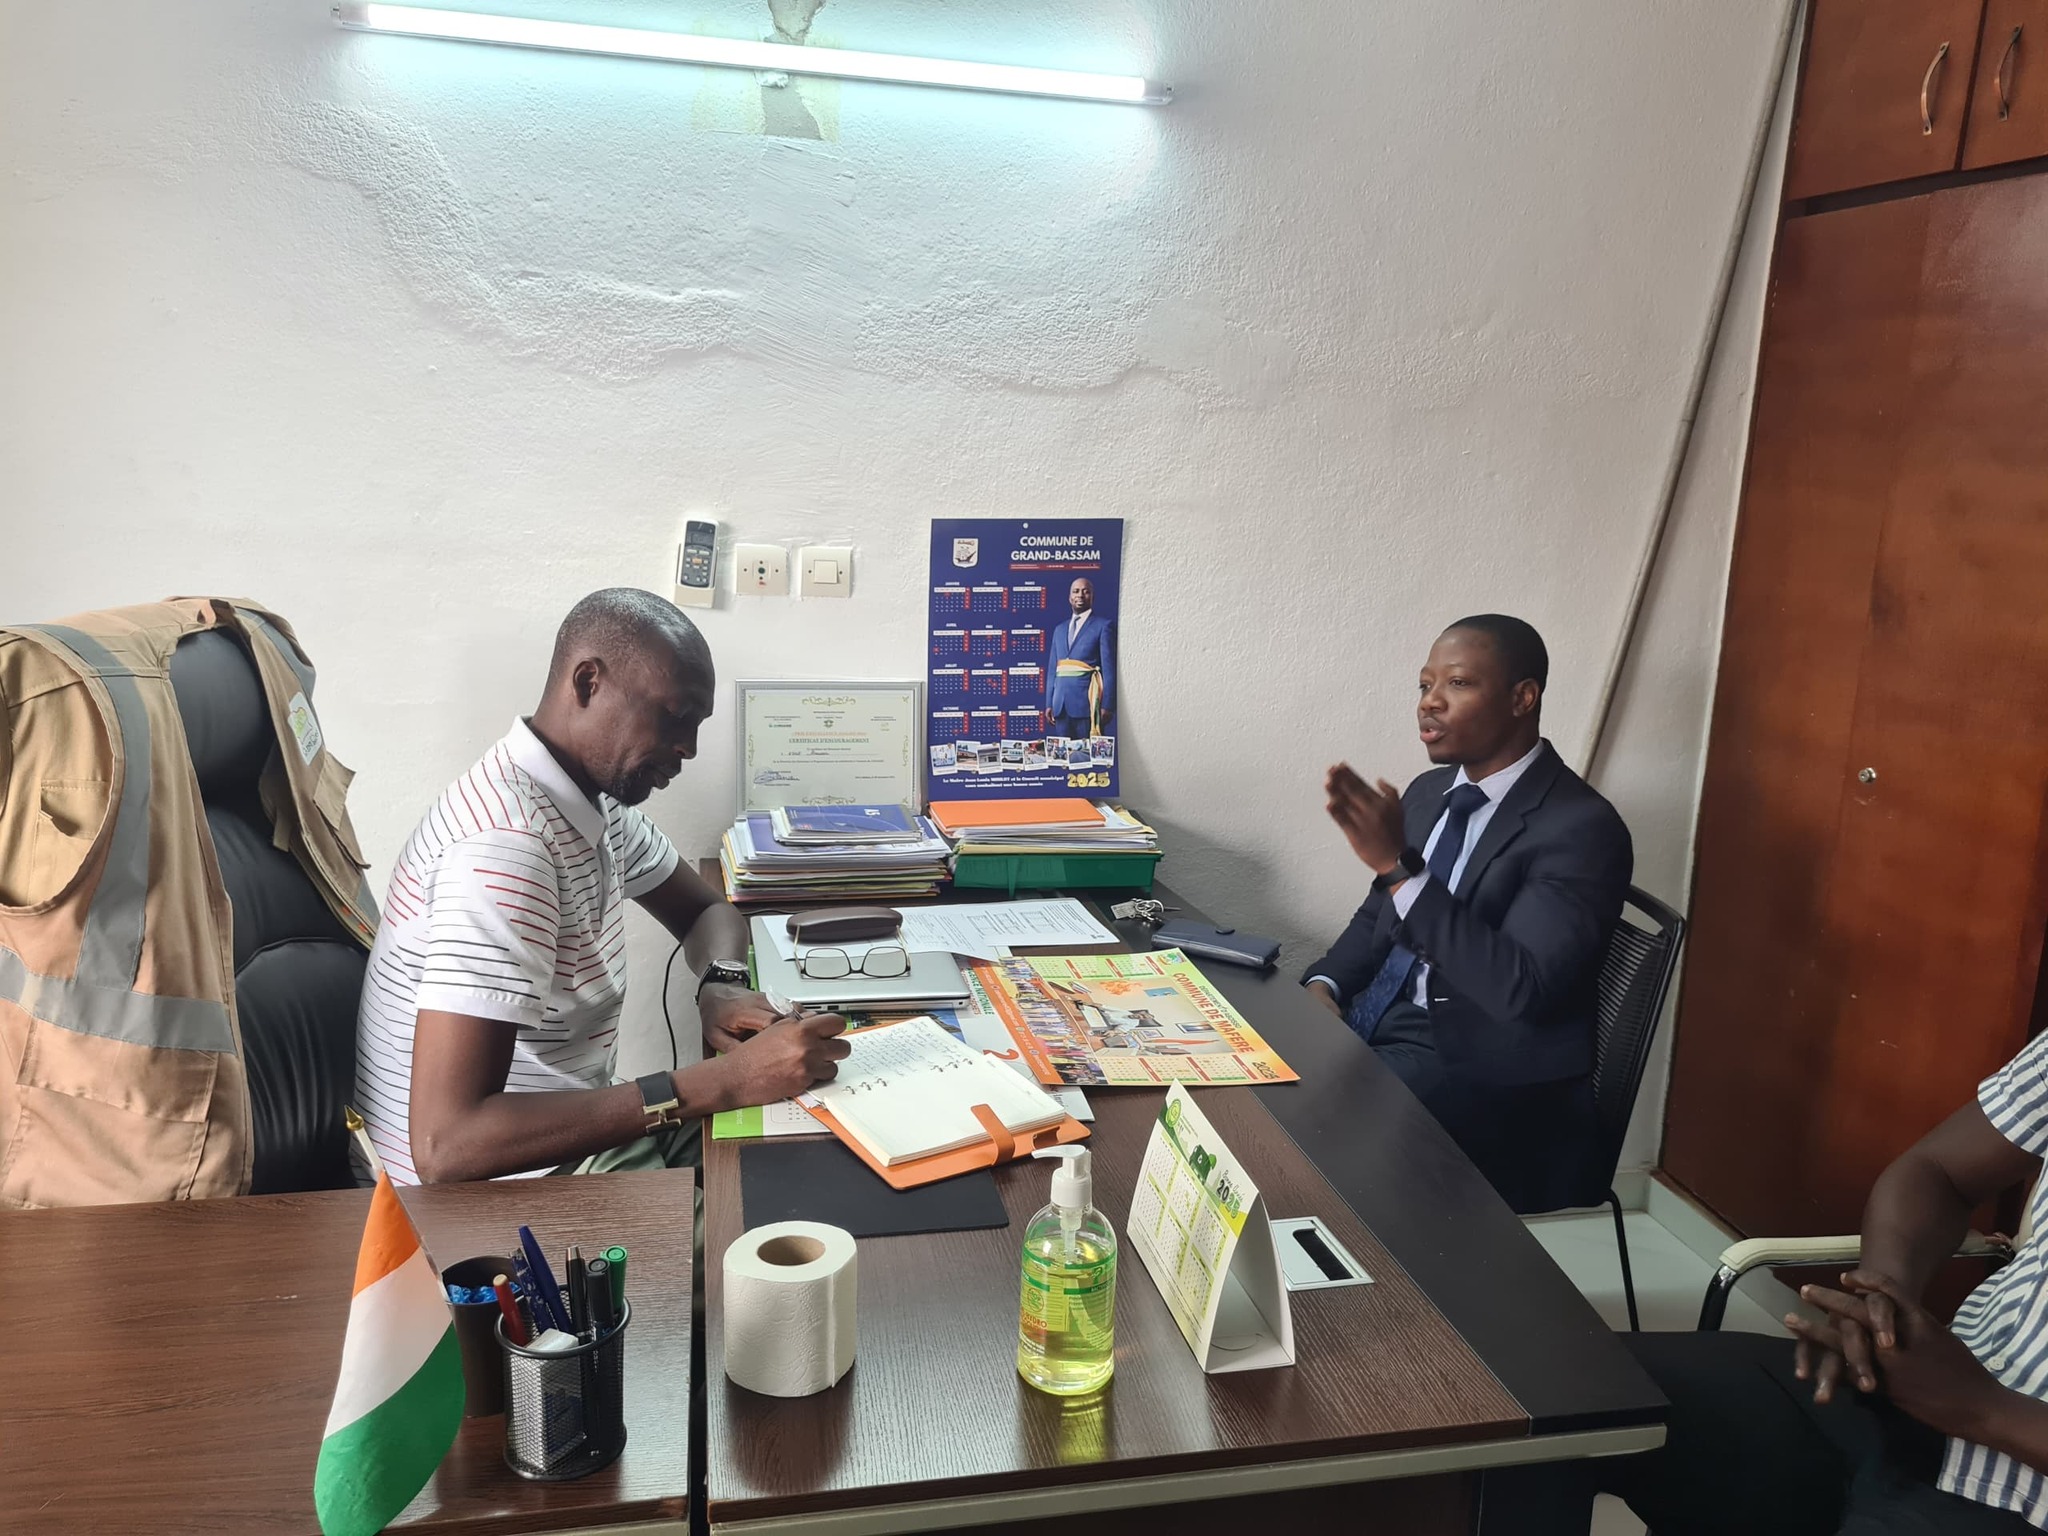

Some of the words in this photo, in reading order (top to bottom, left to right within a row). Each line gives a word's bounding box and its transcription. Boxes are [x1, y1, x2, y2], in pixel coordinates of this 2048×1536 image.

[1020, 536, 1077, 547] COMMUNE
[1080, 536, 1093, 546] DE
[1010, 550, 1100, 561] GRAND-BASSAM
[1067, 772, 1111, 788] 2025
[975, 985, 995, 1015] NATIONALE
[1173, 972, 1214, 1009] COMMUNE
[1206, 1008, 1224, 1020] DE
[1216, 1020, 1255, 1053] MAFERE
[1252, 1061, 1280, 1080] 2025
[1216, 1179, 1241, 1219] 2025
